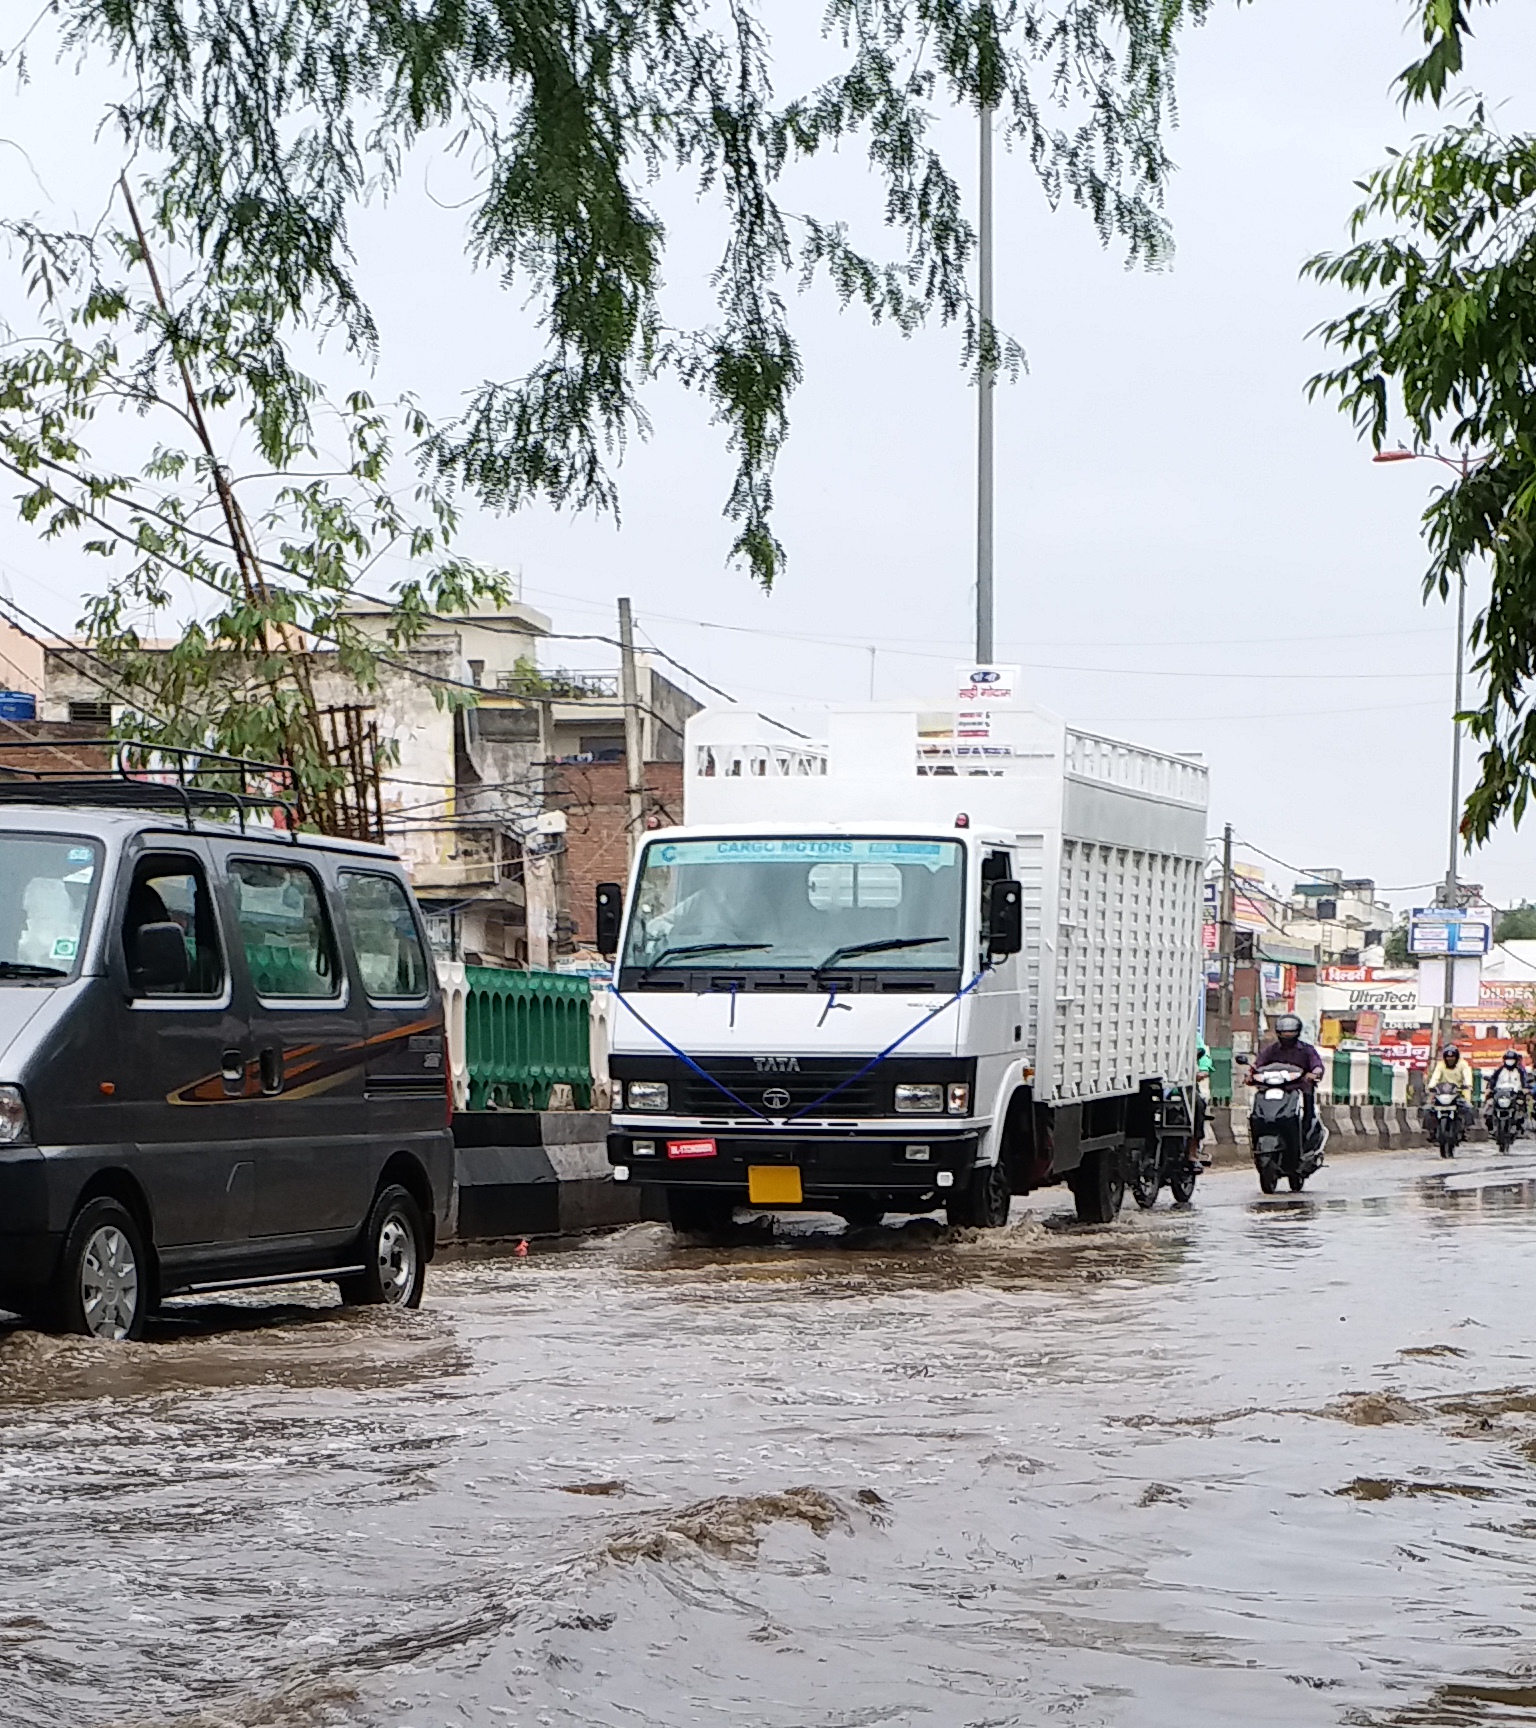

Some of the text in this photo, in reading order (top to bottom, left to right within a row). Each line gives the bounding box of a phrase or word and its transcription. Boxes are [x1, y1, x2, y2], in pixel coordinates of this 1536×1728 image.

[717, 842, 775, 855] CARGO
[781, 841, 853, 855] MOTORS
[1349, 989, 1417, 1003] UltraTech
[753, 1057, 801, 1073] TATA
